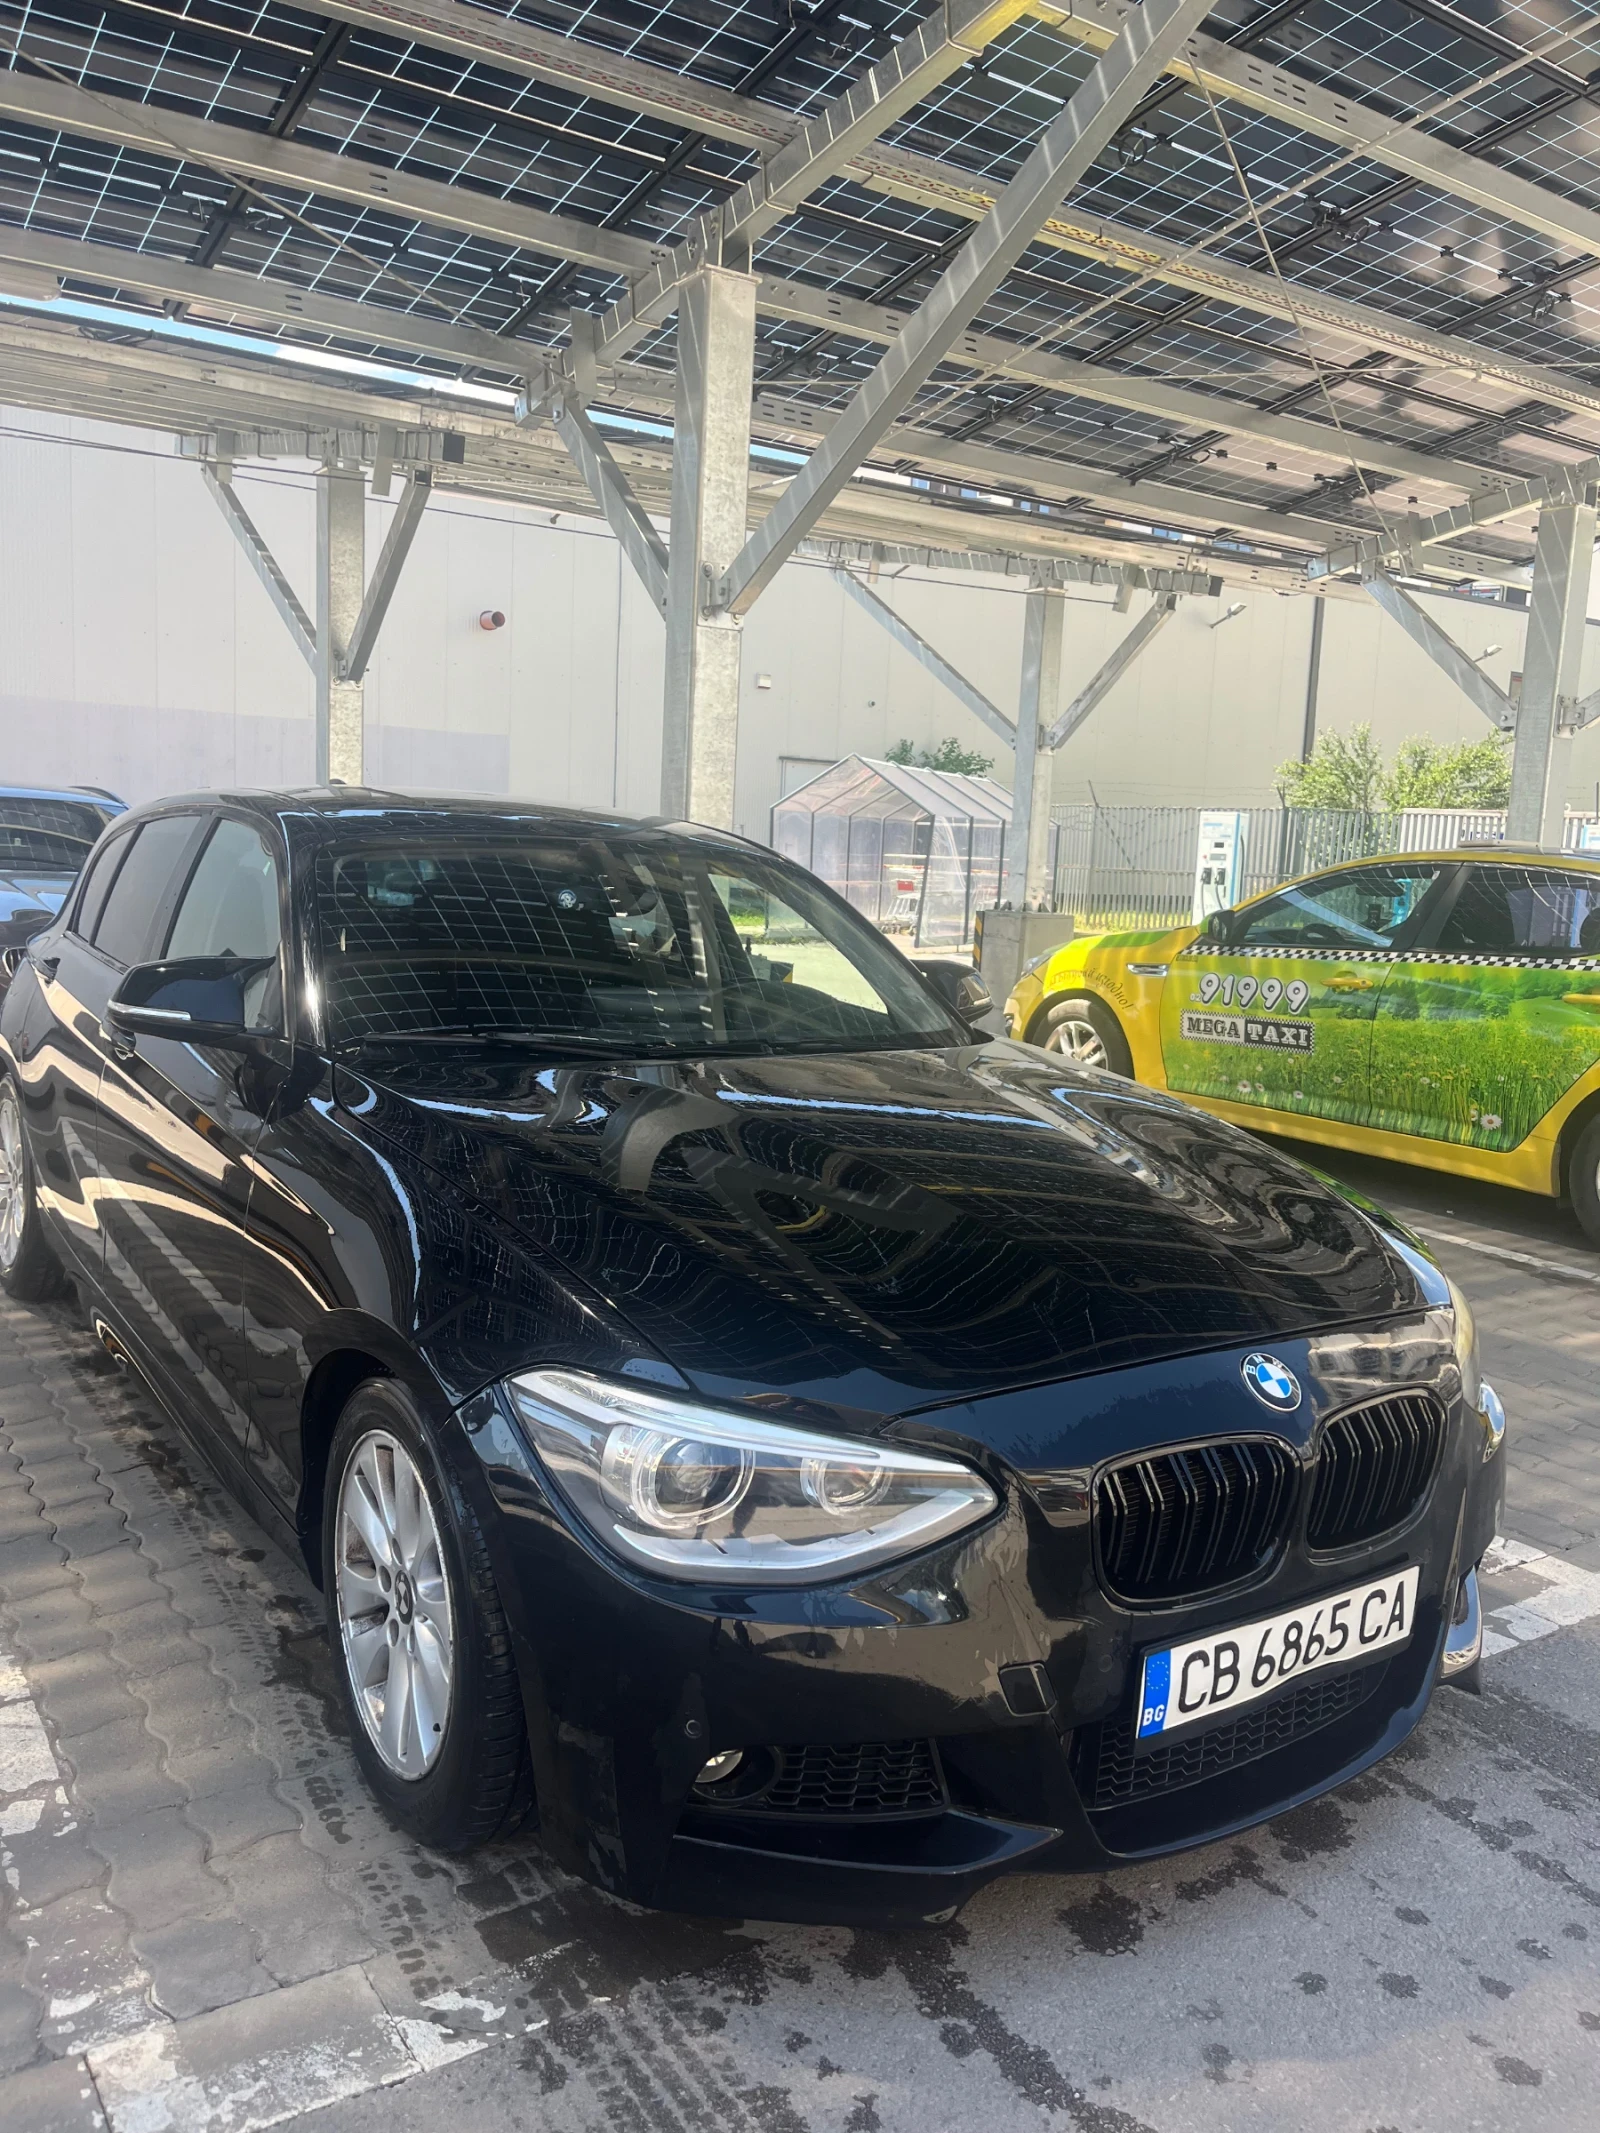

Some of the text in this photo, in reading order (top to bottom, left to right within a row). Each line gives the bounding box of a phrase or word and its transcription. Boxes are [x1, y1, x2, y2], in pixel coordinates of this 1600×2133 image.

[1095, 972, 1135, 1010] изгодно!
[1199, 972, 1309, 1015] 91999
[1186, 1016, 1309, 1047] MEGA TAXI
[1178, 1580, 1404, 1713] CB 6865 CA
[1142, 1704, 1165, 1726] BG
